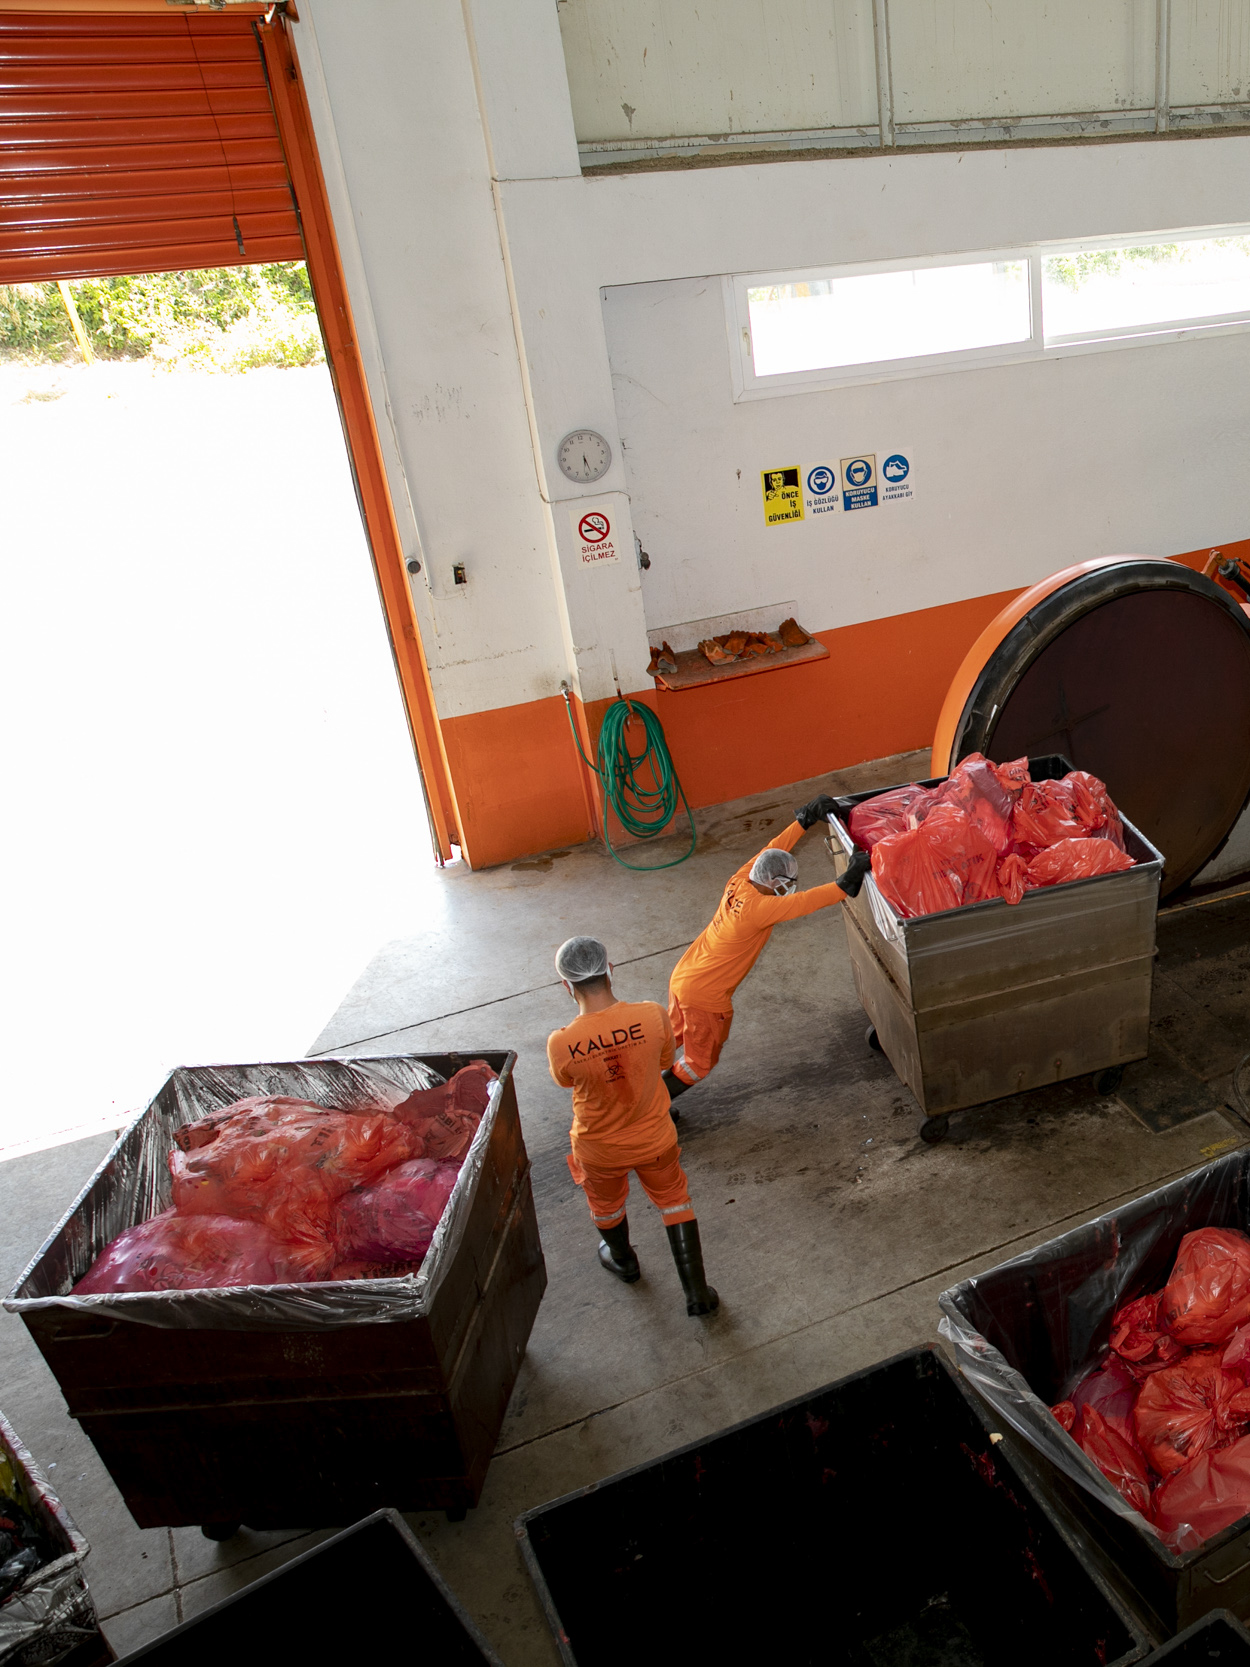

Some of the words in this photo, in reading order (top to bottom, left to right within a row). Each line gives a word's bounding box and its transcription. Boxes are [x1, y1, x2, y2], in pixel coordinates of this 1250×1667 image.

[846, 488, 875, 497] KORUYUCU
[886, 484, 910, 492] KORUYUCU
[782, 490, 799, 500] ÖNCE
[851, 494, 870, 502] MASKE
[882, 492, 904, 500] AYAKKABI
[790, 500, 796, 508] İŞ
[806, 500, 812, 508] İŞ
[814, 495, 839, 506] GÖZLÜĞÜ
[851, 501, 872, 509] KULLAN
[812, 506, 834, 514] KULLAN
[768, 509, 801, 522] GÜVENLİĞİ
[582, 542, 614, 554] SİGARA
[582, 550, 616, 564] İÇİLMEZ
[568, 1022, 645, 1059] KALDE
